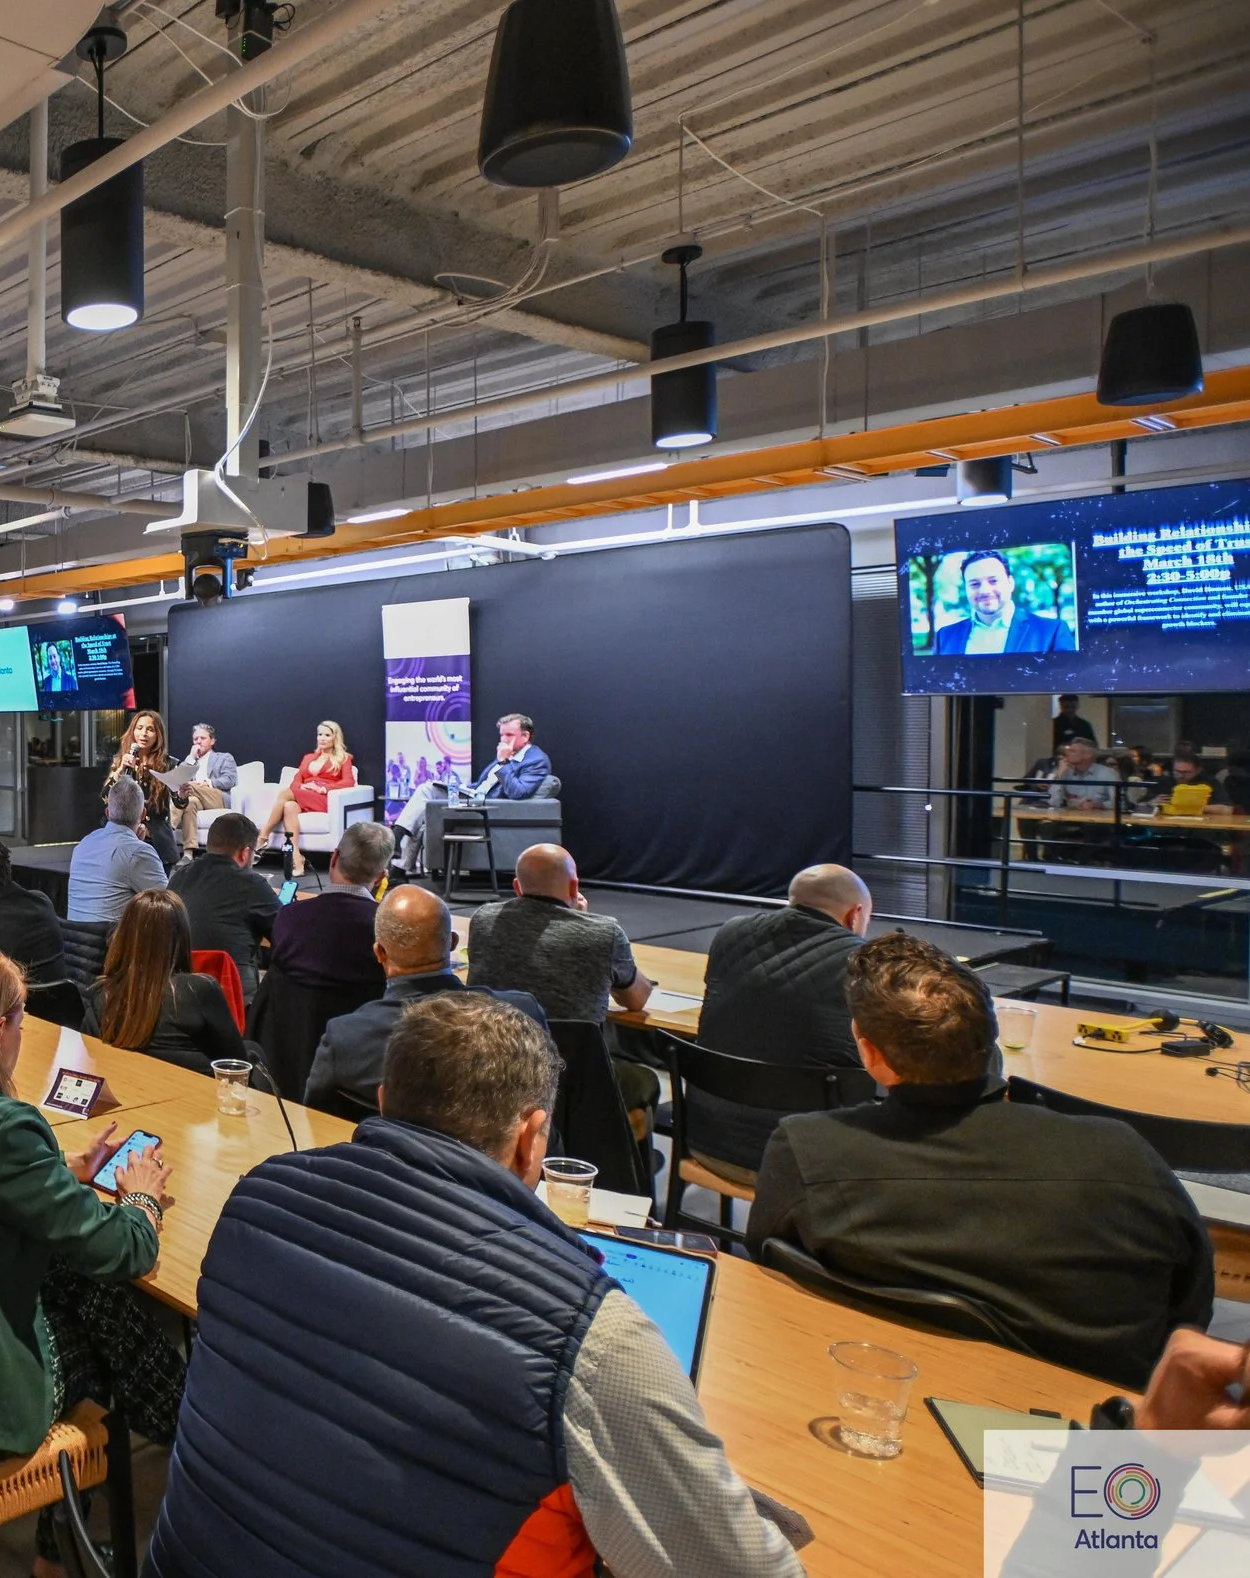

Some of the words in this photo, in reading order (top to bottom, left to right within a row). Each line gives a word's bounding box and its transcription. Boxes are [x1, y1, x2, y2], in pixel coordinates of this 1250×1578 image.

[1092, 531, 1156, 547] Building
[1118, 545, 1144, 558] the
[1146, 541, 1192, 556] Speed
[1195, 539, 1213, 553] of
[1142, 555, 1193, 571] March
[1197, 552, 1235, 567] 18th
[387, 676, 415, 685] Engaging
[427, 675, 446, 683] world's
[389, 684, 419, 693] influential
[419, 684, 451, 693] community
[452, 684, 460, 692] of
[403, 695, 446, 703] entrepreneurs.
